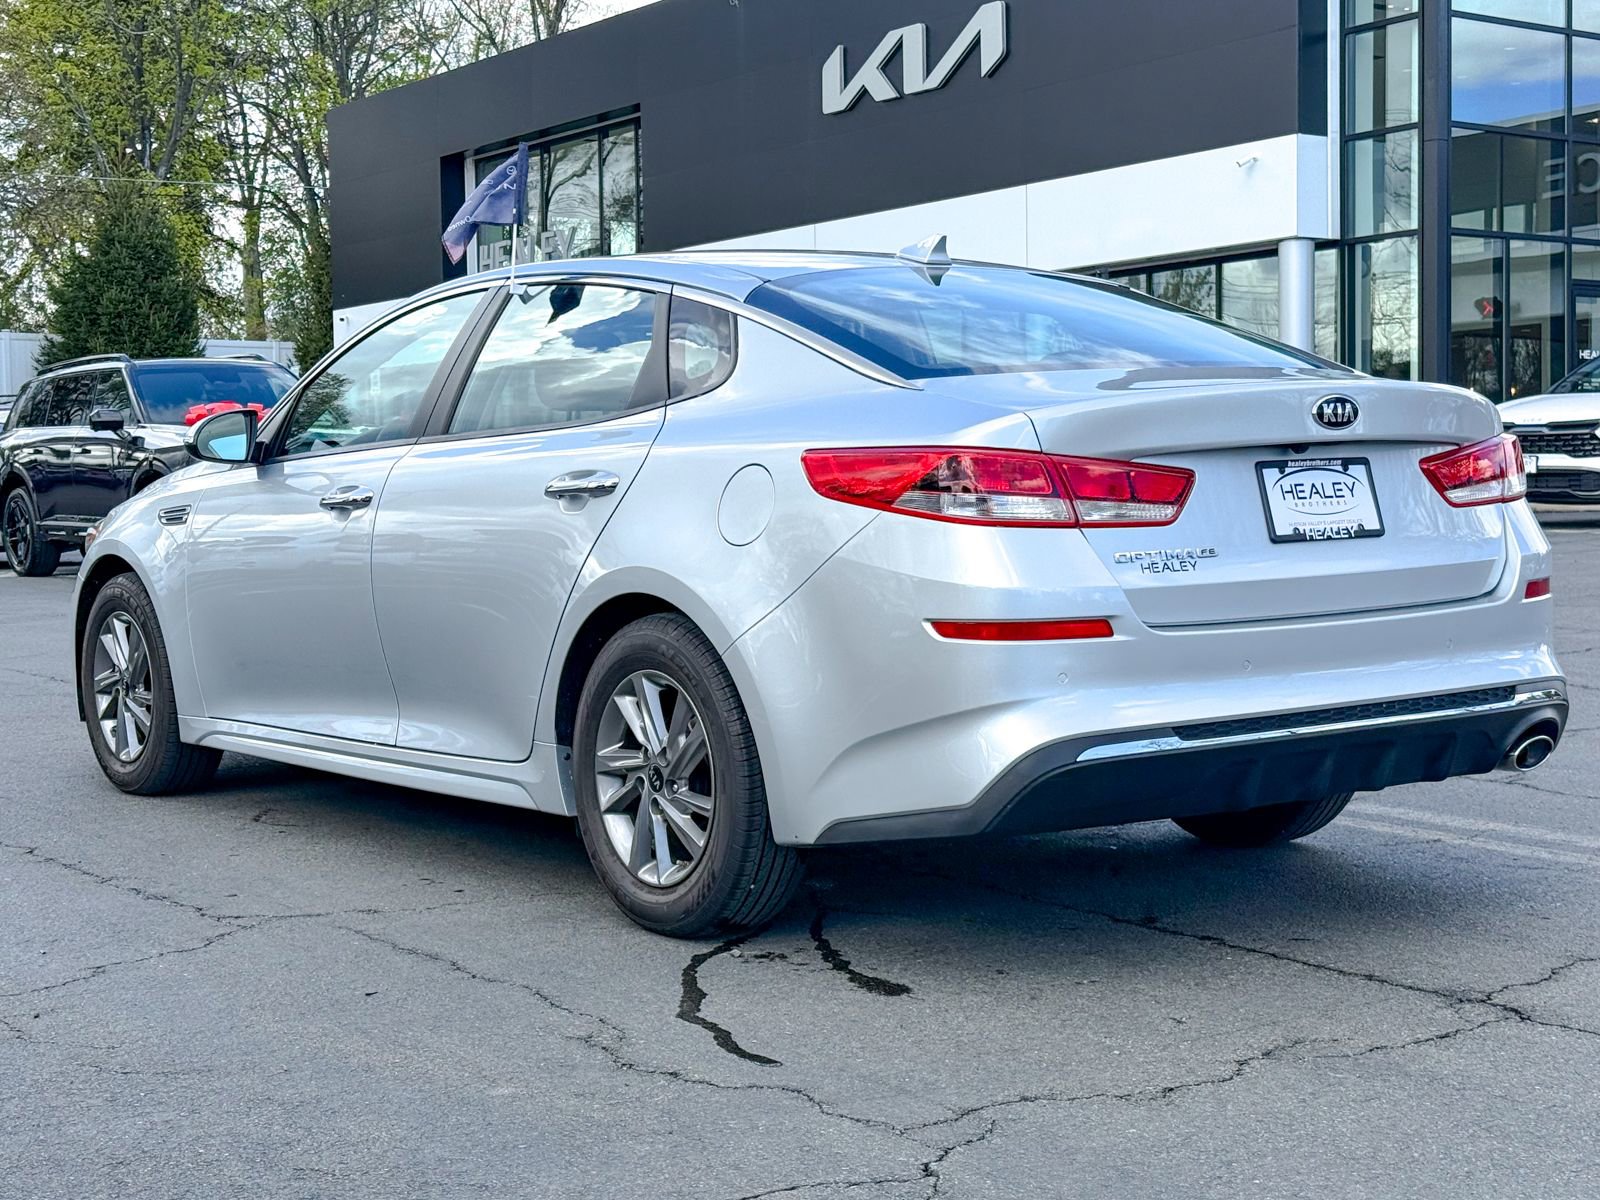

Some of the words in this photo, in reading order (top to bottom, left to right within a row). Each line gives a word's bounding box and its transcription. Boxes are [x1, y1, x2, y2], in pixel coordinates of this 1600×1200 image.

[822, 1, 1006, 115] KIA
[1322, 402, 1355, 423] KIA
[1280, 482, 1355, 500] HEALEY
[1305, 526, 1355, 540] HEALEY
[1114, 548, 1196, 563] OPTIMA
[1141, 560, 1197, 575] HEALEY
